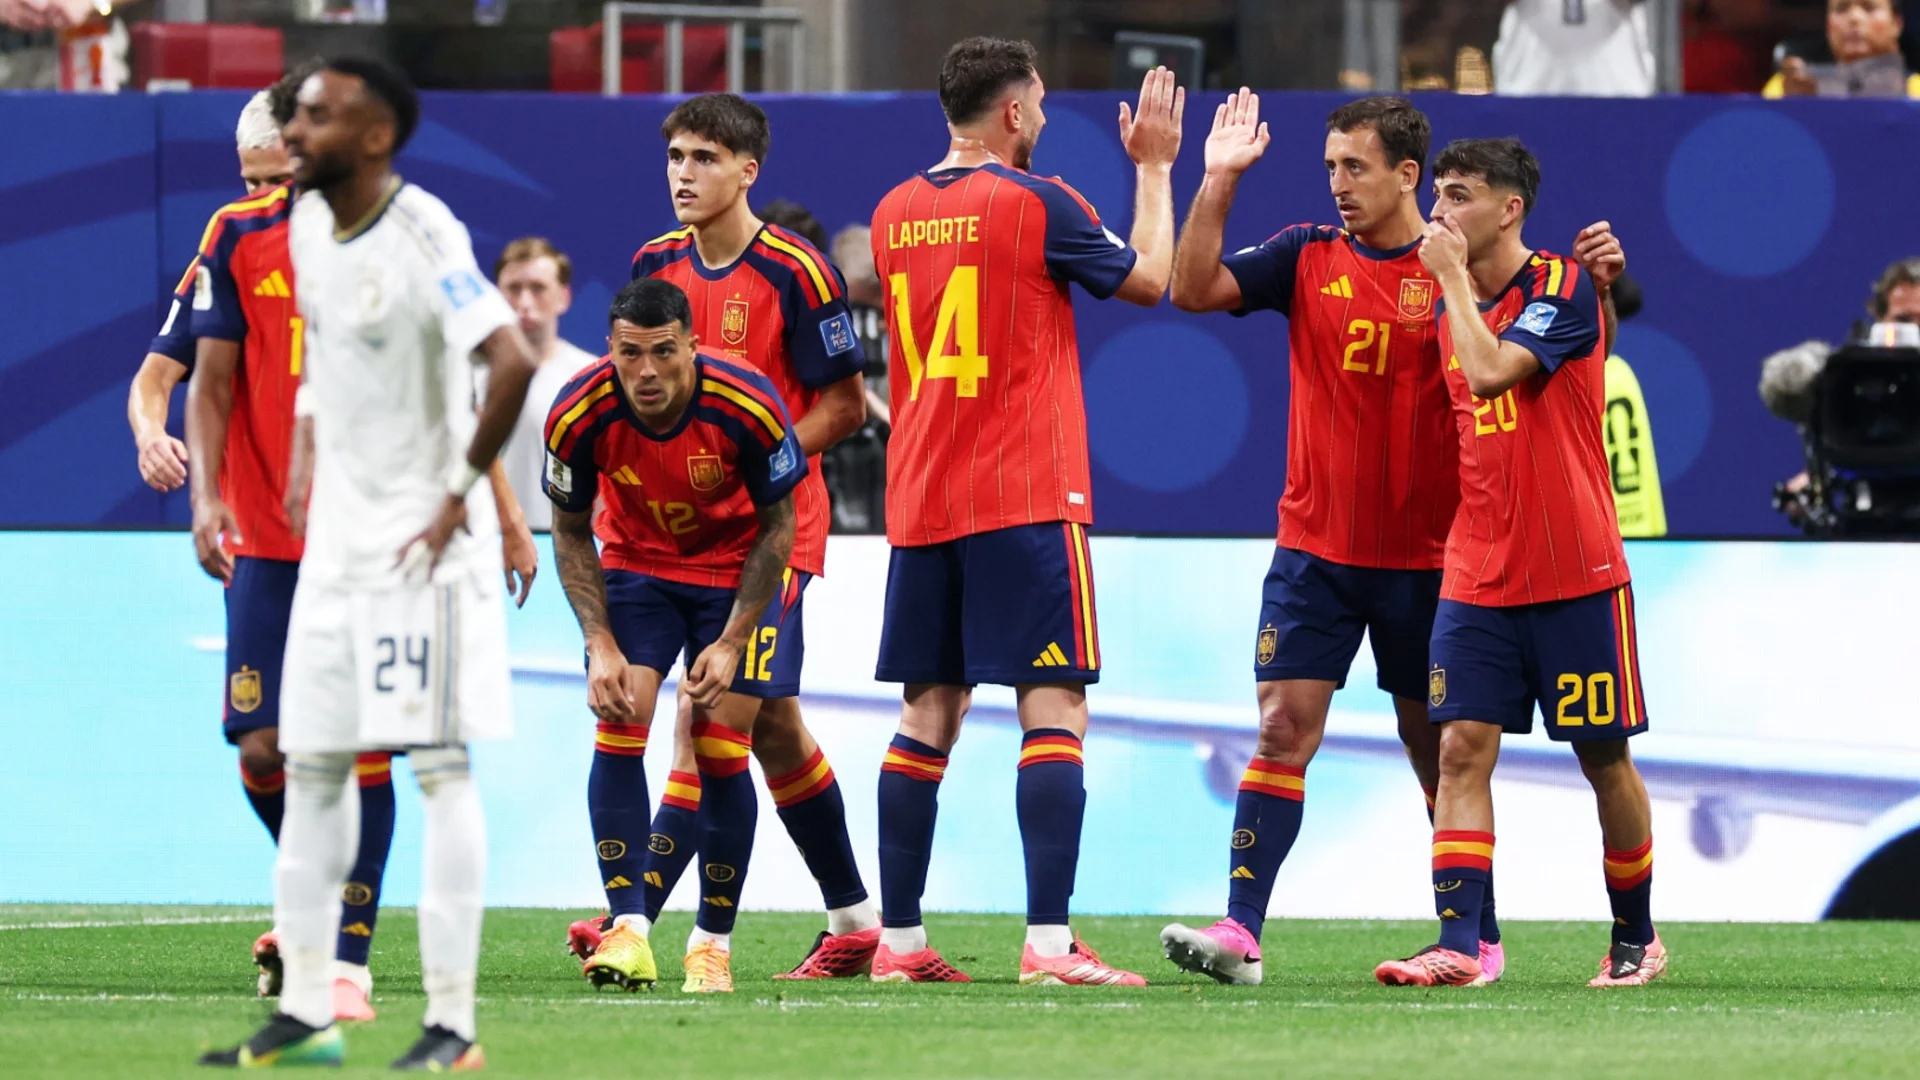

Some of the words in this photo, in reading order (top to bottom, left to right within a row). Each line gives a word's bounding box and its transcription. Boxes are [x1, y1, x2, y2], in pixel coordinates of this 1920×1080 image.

[889, 216, 980, 250] LAPORTE
[290, 316, 304, 374] 1
[888, 265, 989, 401] 14
[1343, 319, 1390, 376] 21
[1471, 389, 1518, 437] 20
[646, 500, 700, 534] 12
[376, 635, 429, 691] 24
[744, 625, 777, 681] 12
[1557, 672, 1615, 726] 20
